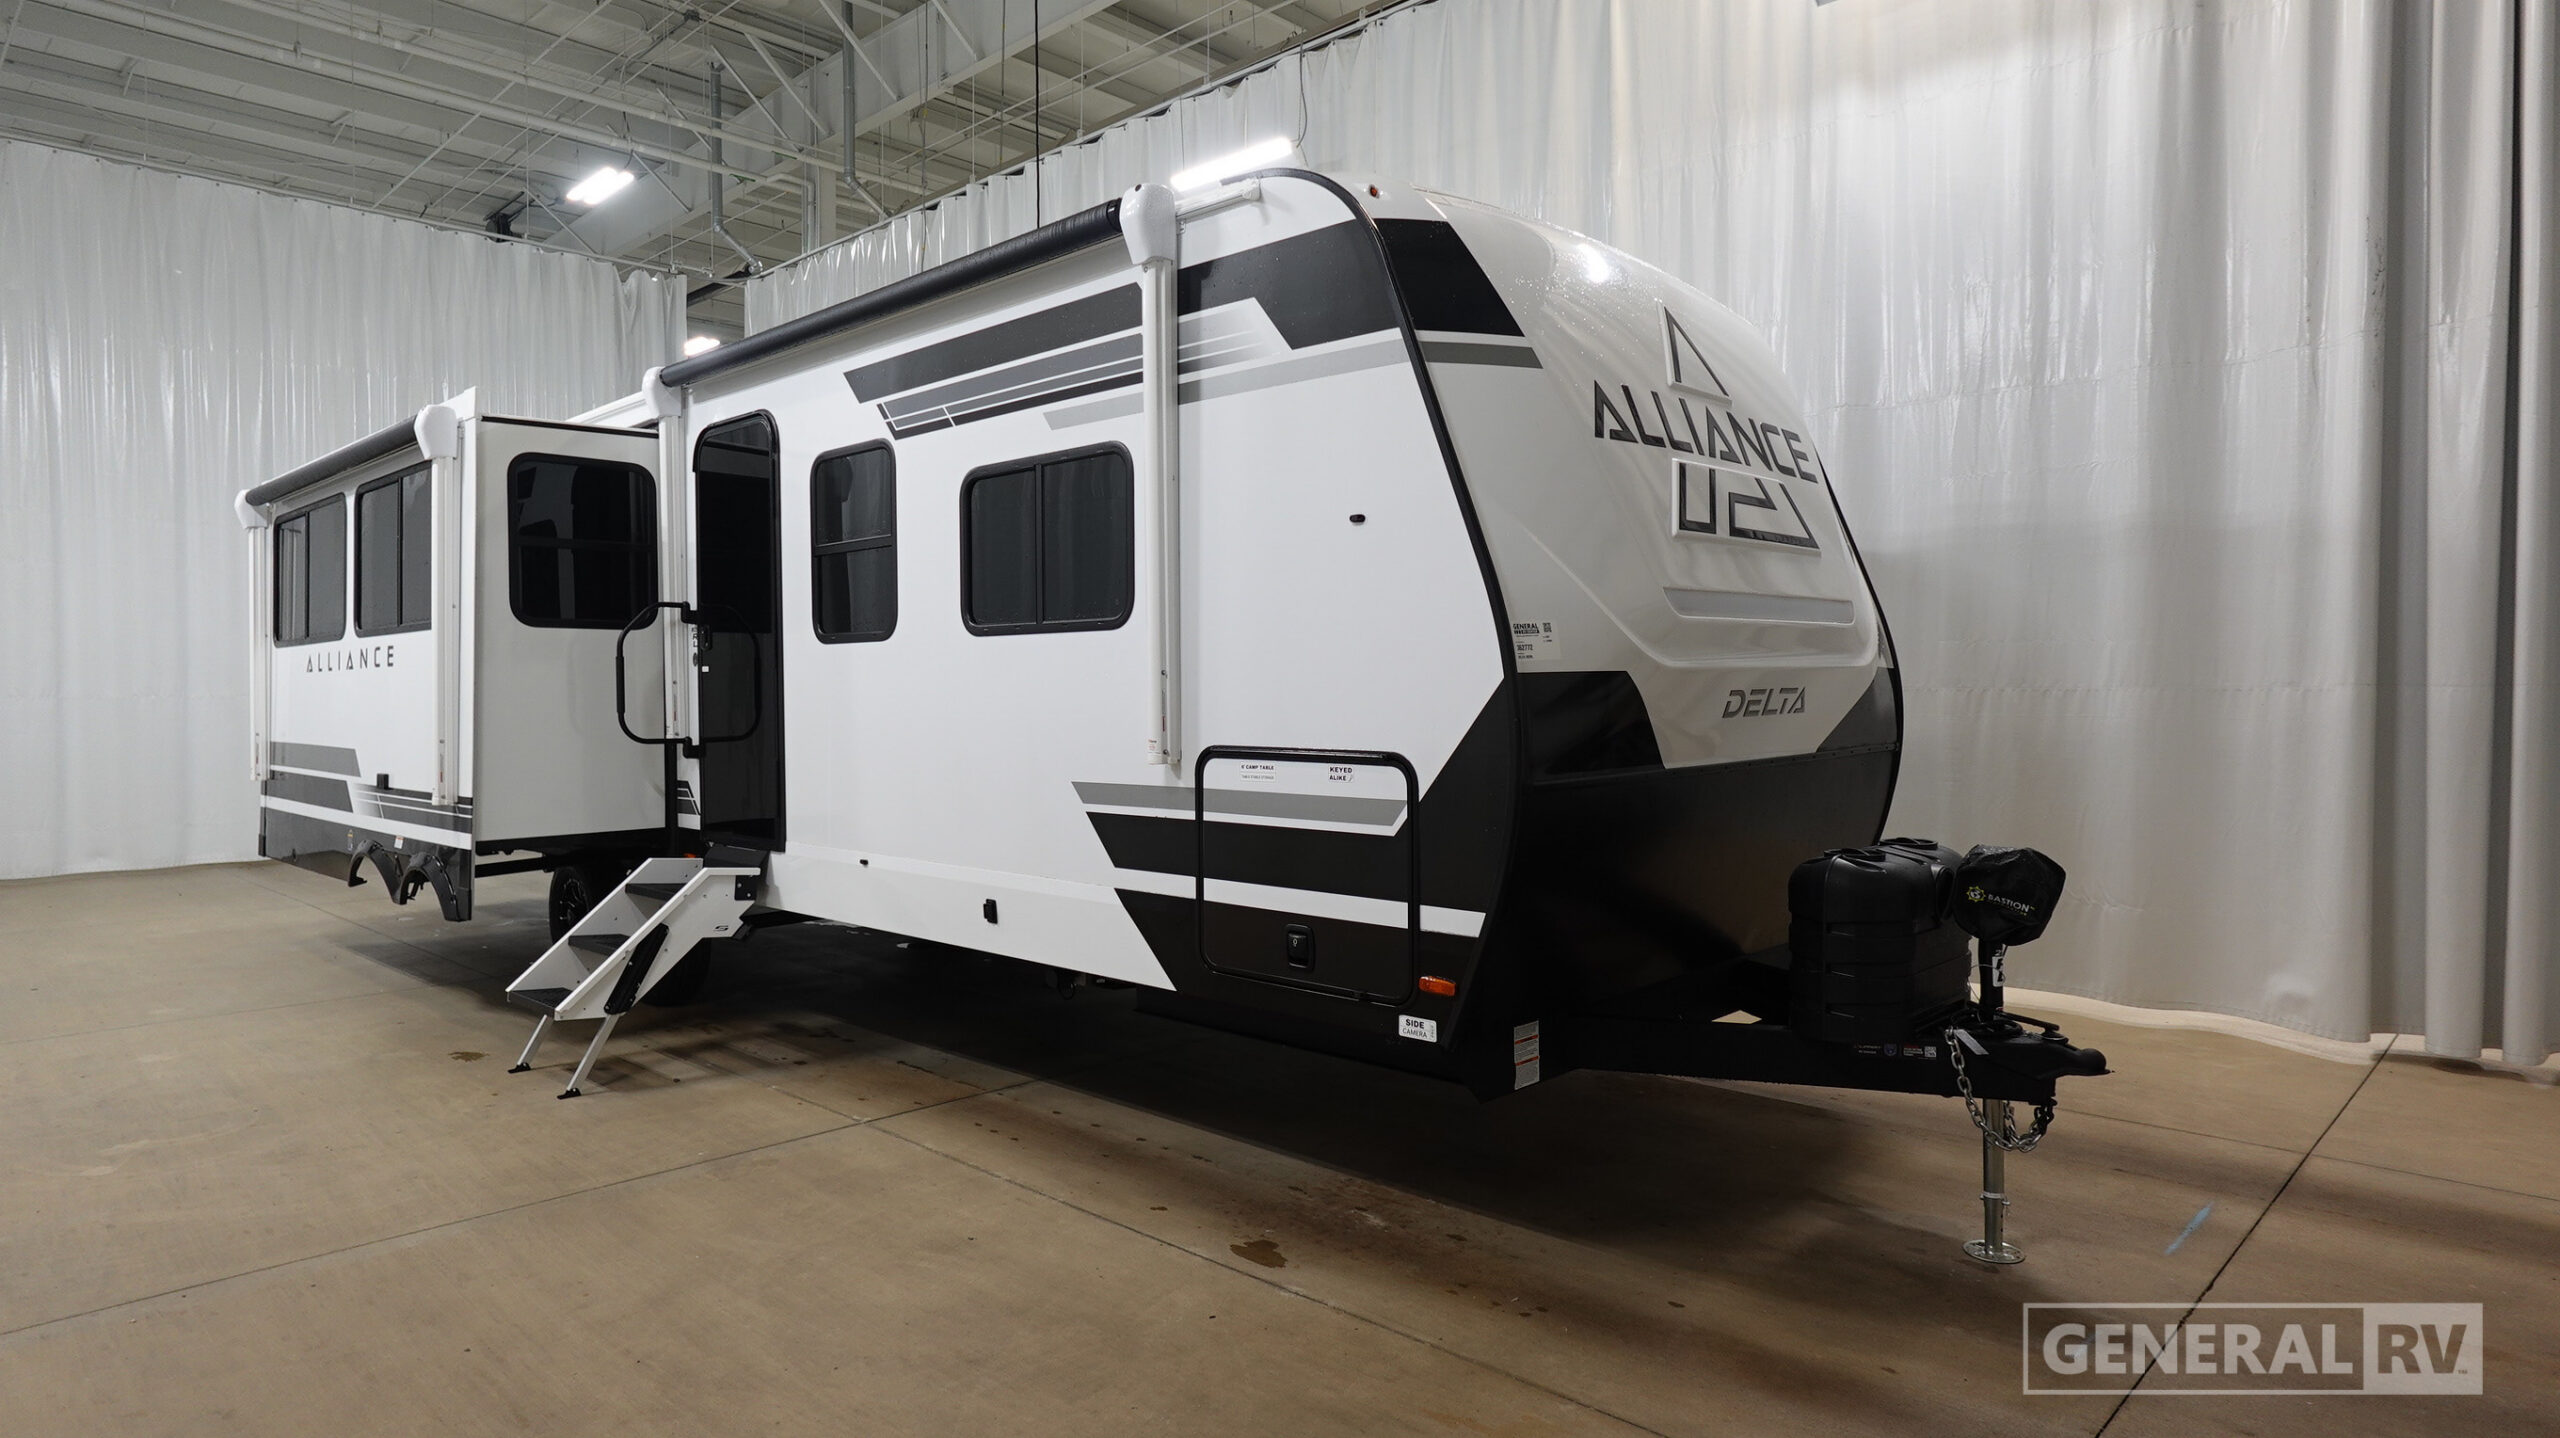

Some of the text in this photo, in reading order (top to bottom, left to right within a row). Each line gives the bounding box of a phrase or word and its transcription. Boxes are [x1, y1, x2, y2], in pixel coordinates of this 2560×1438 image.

[1593, 379, 1818, 483] ALLIANCE
[307, 645, 394, 672] ALLIANCE
[1721, 686, 1806, 719] DELTA
[1329, 766, 1353, 774] KEYED
[1987, 893, 2030, 913] BASTION
[1402, 1028, 1428, 1038] CAMERA
[1405, 1018, 1425, 1029] SIDE
